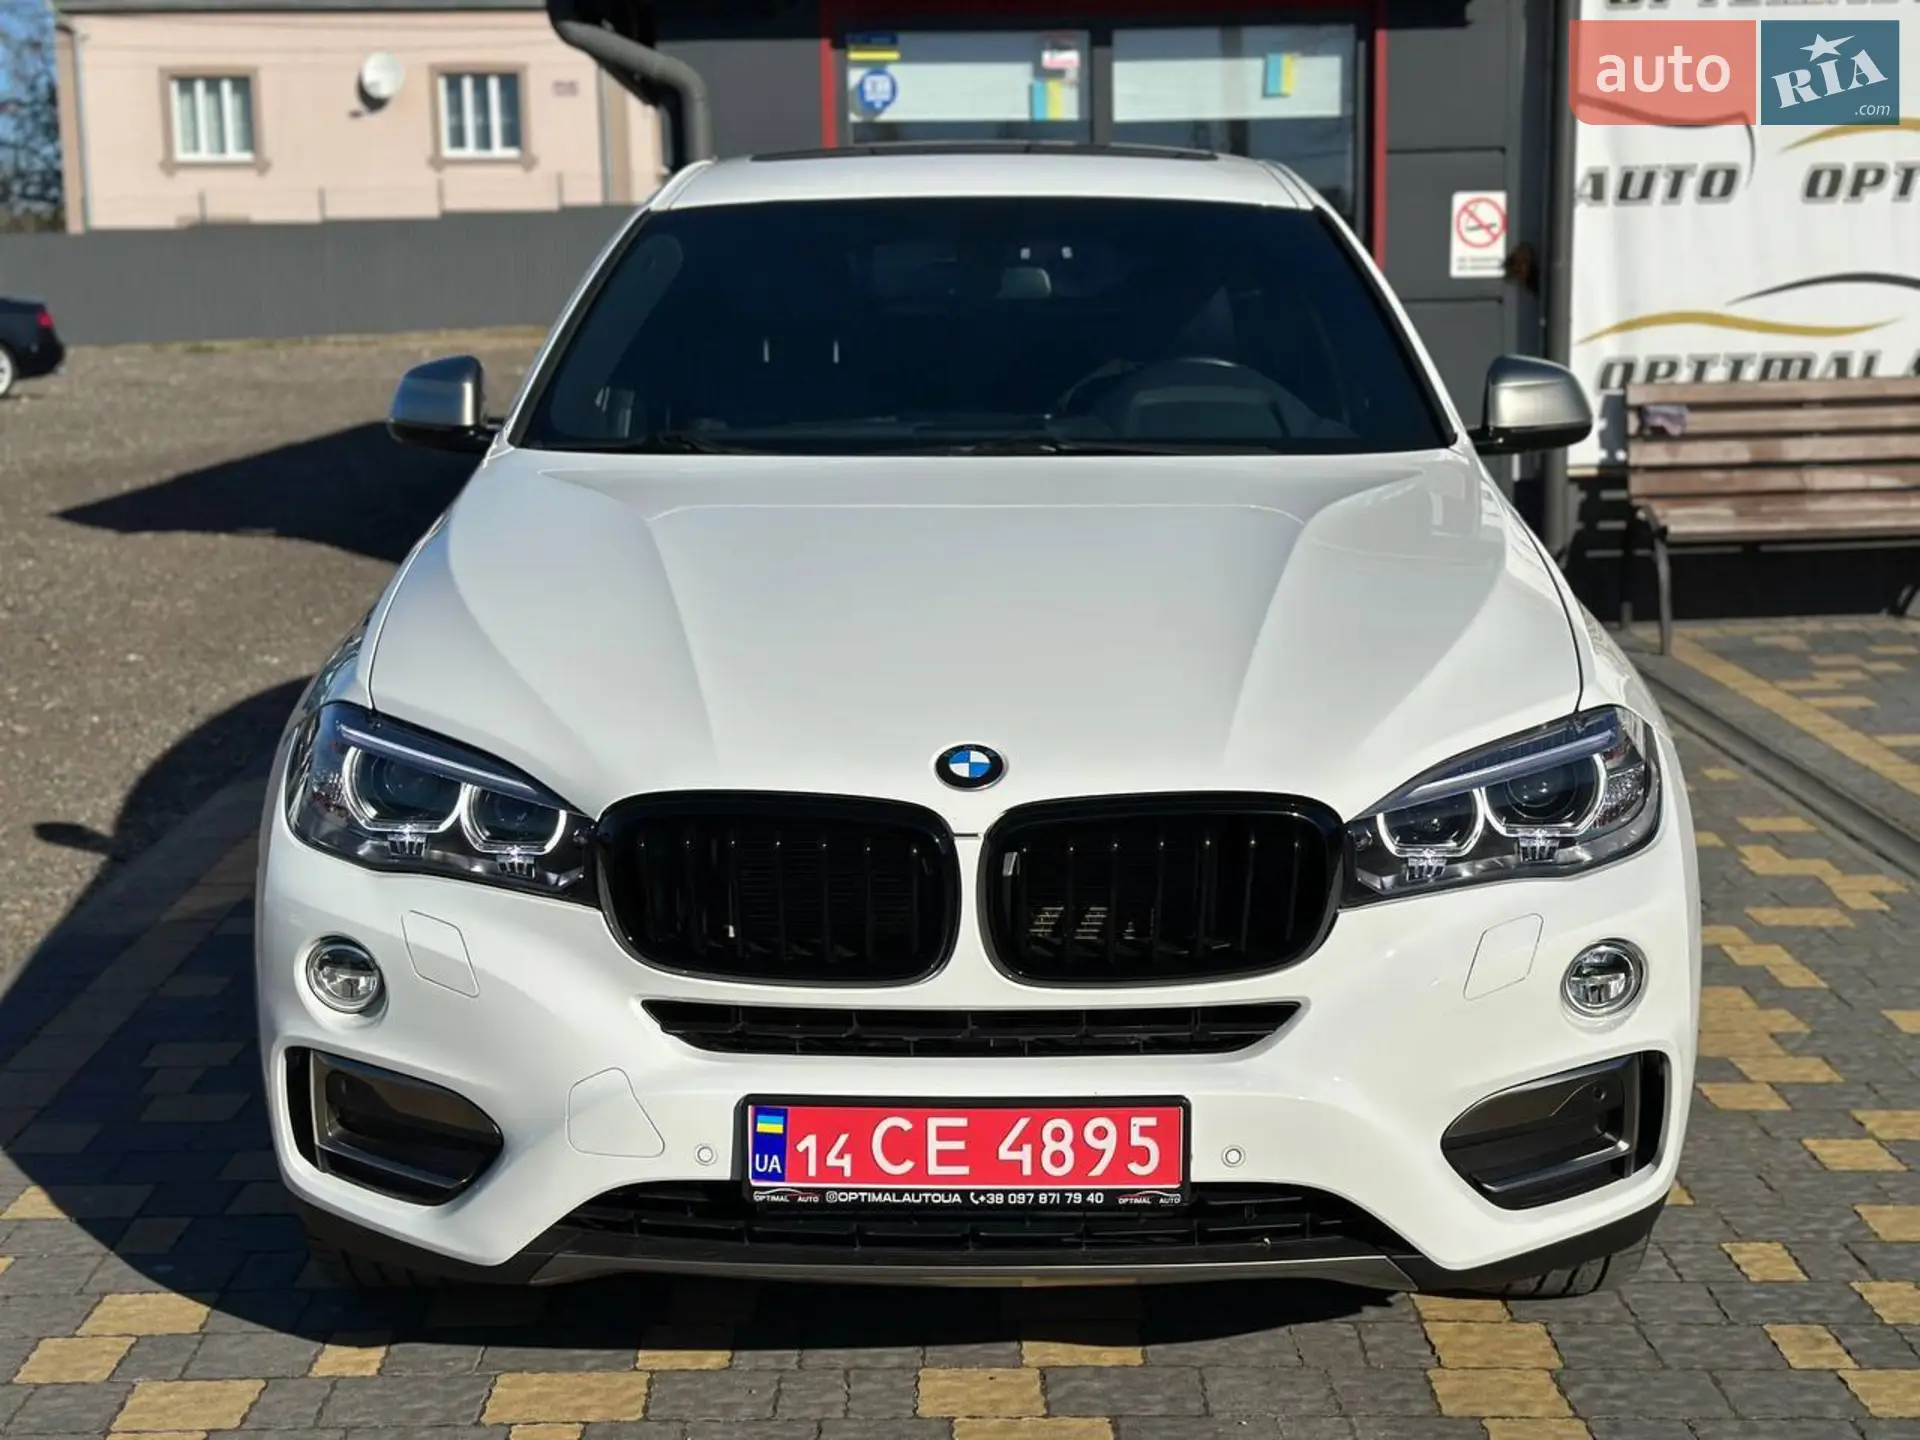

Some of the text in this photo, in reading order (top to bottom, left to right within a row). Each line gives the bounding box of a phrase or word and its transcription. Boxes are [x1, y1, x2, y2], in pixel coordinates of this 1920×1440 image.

[1575, 163, 1742, 207] AUTO
[796, 1116, 1161, 1177] 14 CE 4895
[755, 1154, 783, 1174] UA
[1008, 1193, 1034, 1205] 097
[1039, 1193, 1060, 1204] 871
[1065, 1192, 1082, 1204] 79
[1086, 1192, 1104, 1204] 40
[1118, 1196, 1181, 1205] OPTIMAL AUTO
